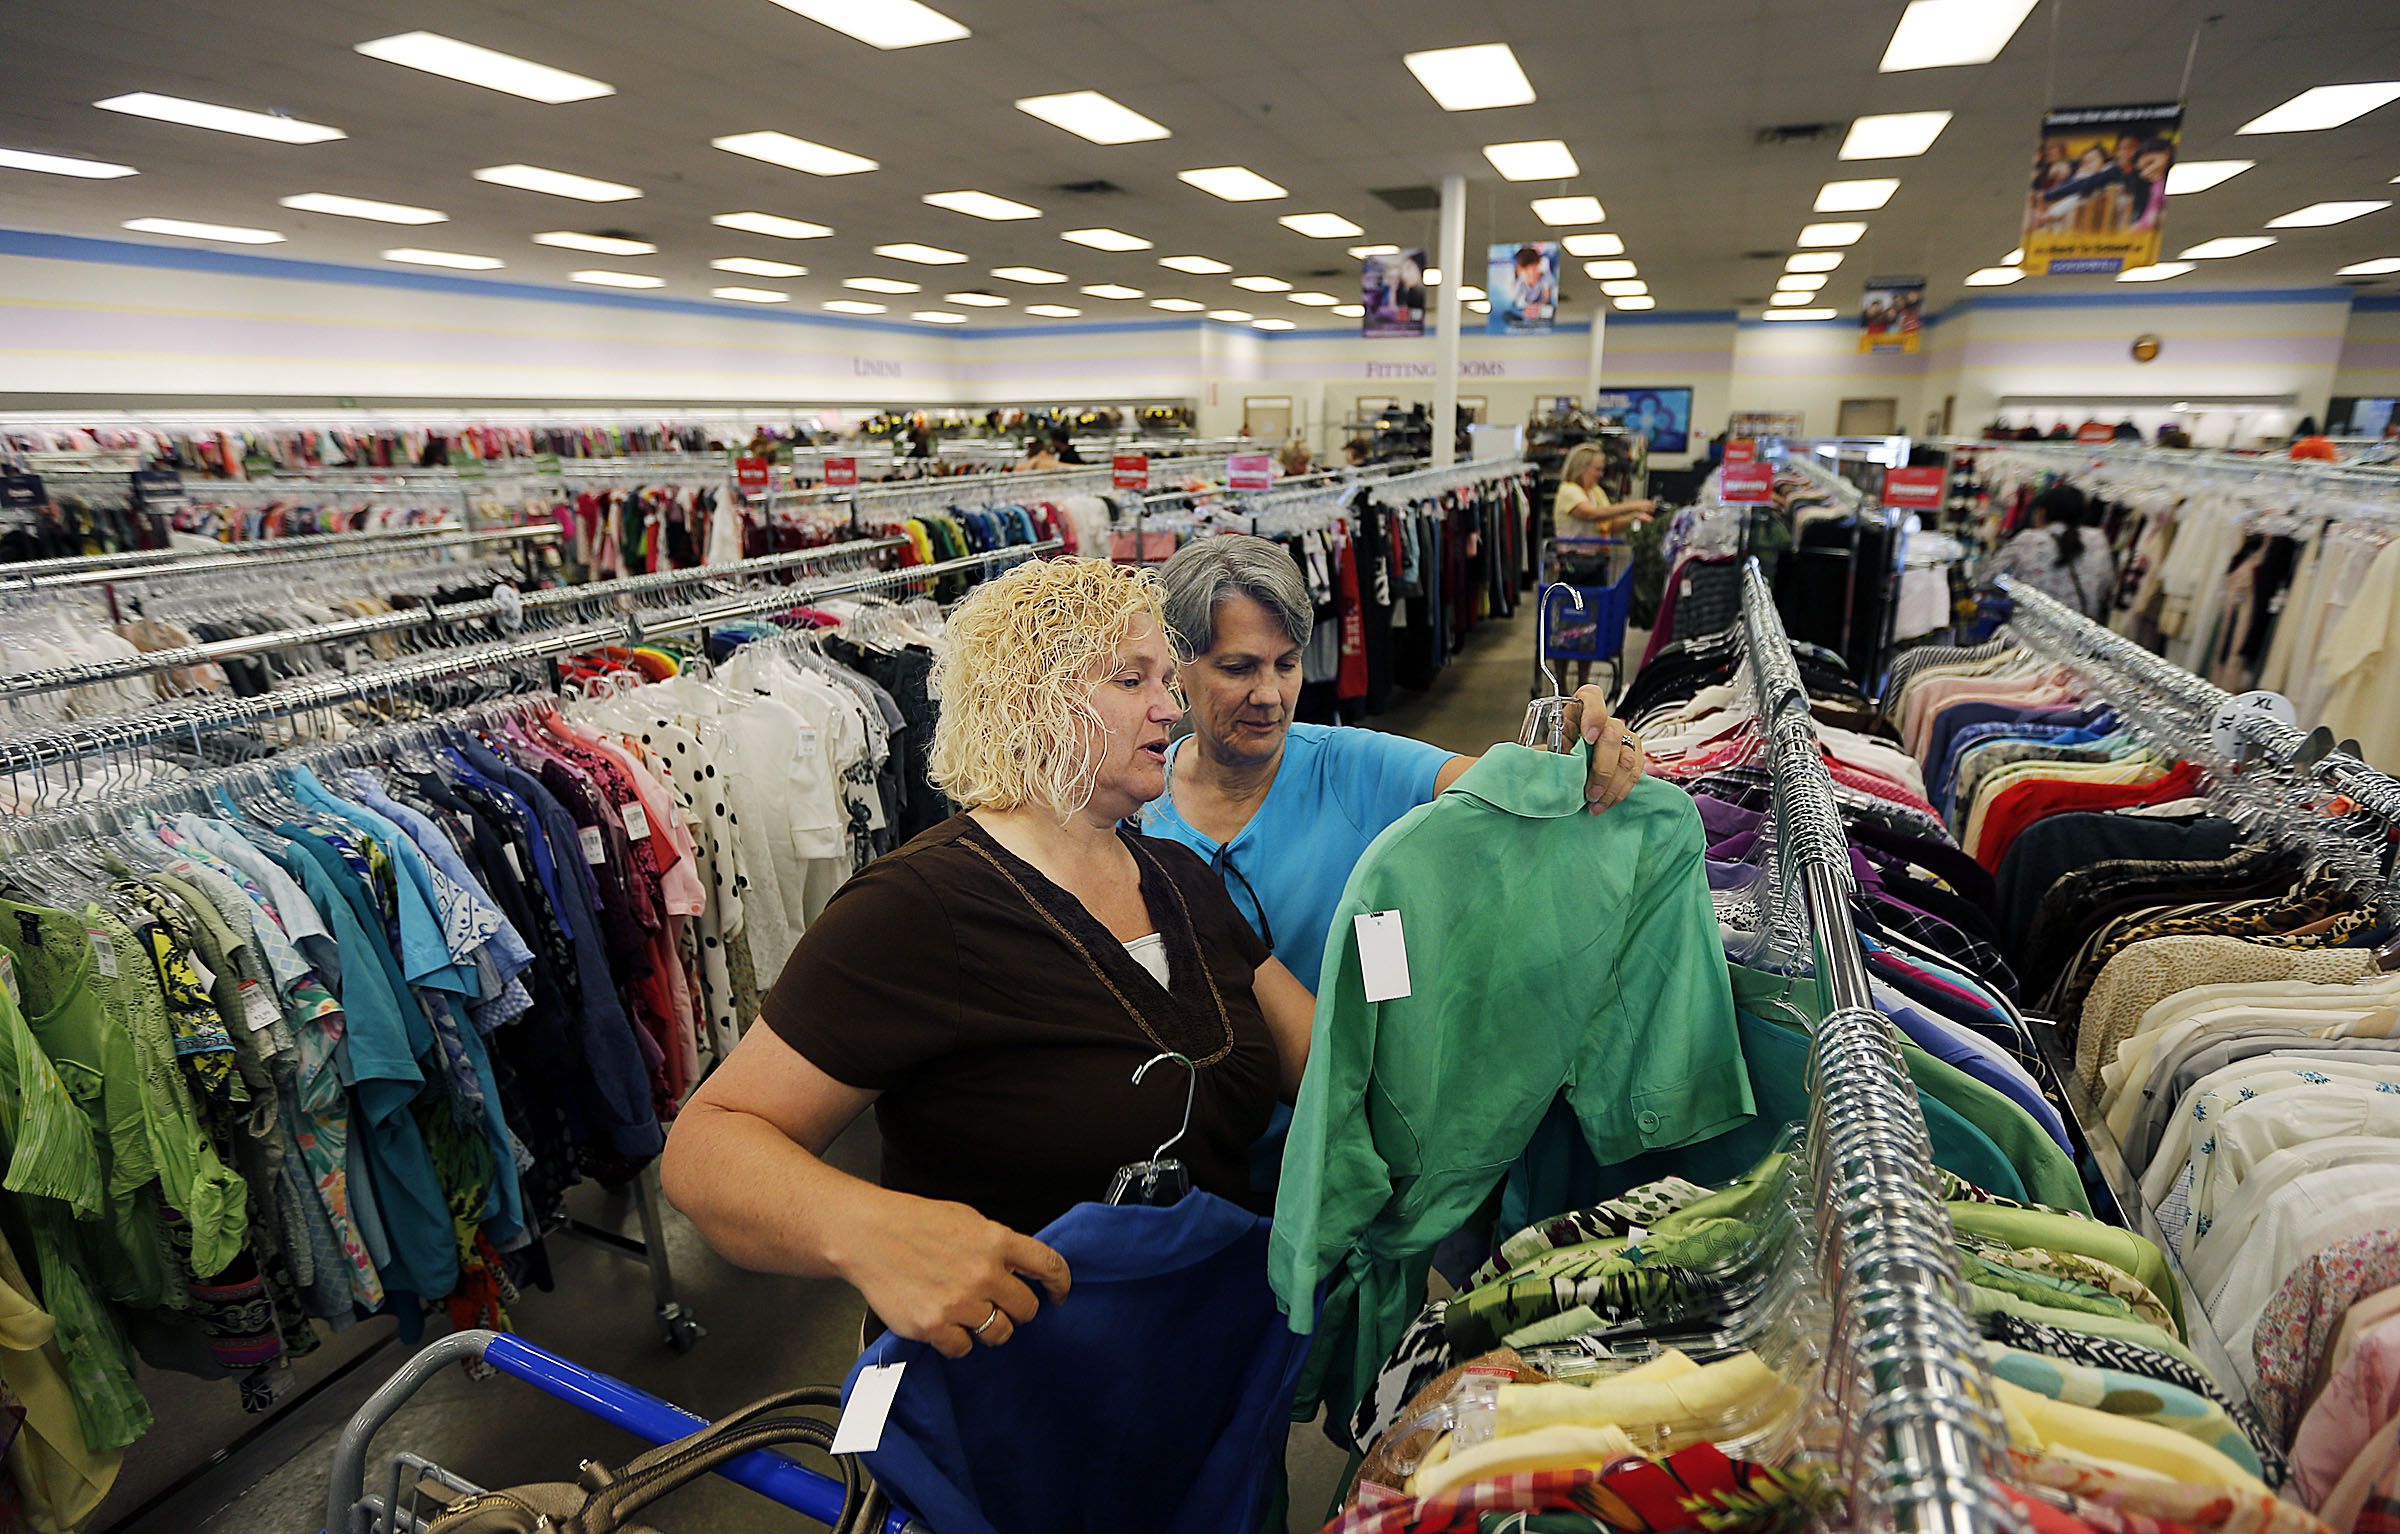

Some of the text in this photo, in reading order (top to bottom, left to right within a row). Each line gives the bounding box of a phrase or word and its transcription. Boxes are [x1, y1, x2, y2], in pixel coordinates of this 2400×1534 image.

[1366, 359, 1505, 378] FITTING OOMS
[2252, 696, 2273, 711] XL
[2217, 713, 2237, 731] XL
